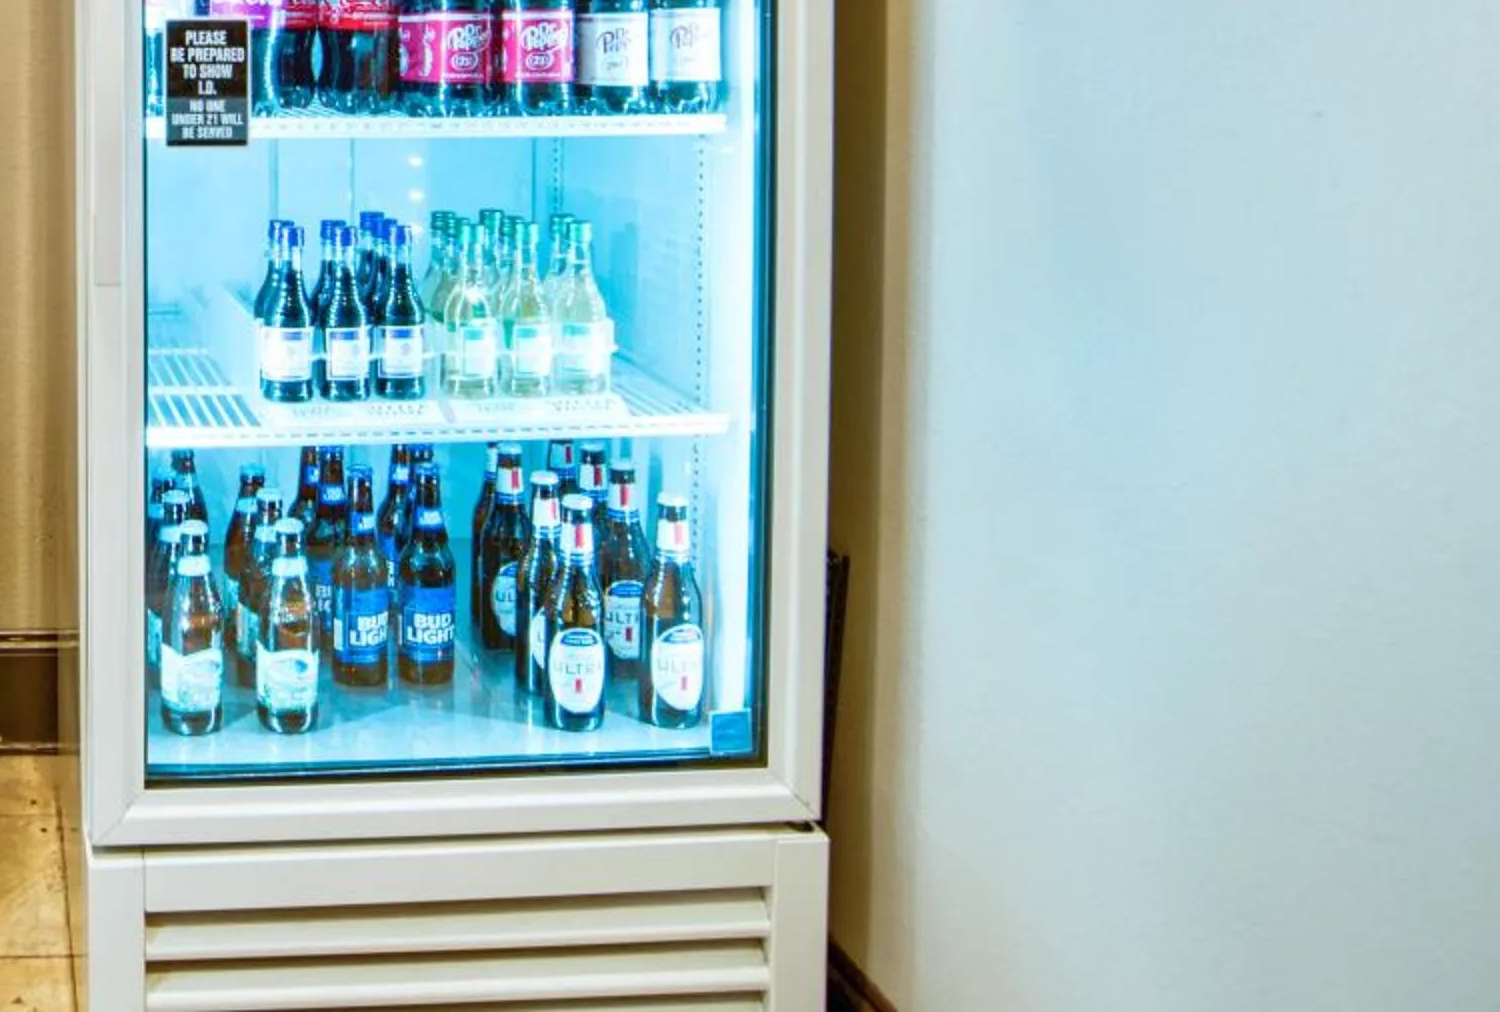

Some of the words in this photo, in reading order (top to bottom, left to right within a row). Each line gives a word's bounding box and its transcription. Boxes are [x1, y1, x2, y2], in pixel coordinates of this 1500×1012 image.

[185, 30, 227, 45] PLEASE
[170, 47, 185, 62] BE
[187, 47, 245, 63] PREPARED
[182, 64, 197, 79] TO
[199, 63, 233, 79] SHOW
[189, 99, 205, 112] NO
[171, 113, 204, 125] UNDER
[206, 113, 218, 125] 21
[221, 113, 244, 125] WILL
[182, 126, 195, 139] BE
[197, 126, 233, 139] SERVED
[414, 612, 453, 628] BUD
[350, 627, 388, 646] LIGH
[407, 623, 455, 645] LIGHT
